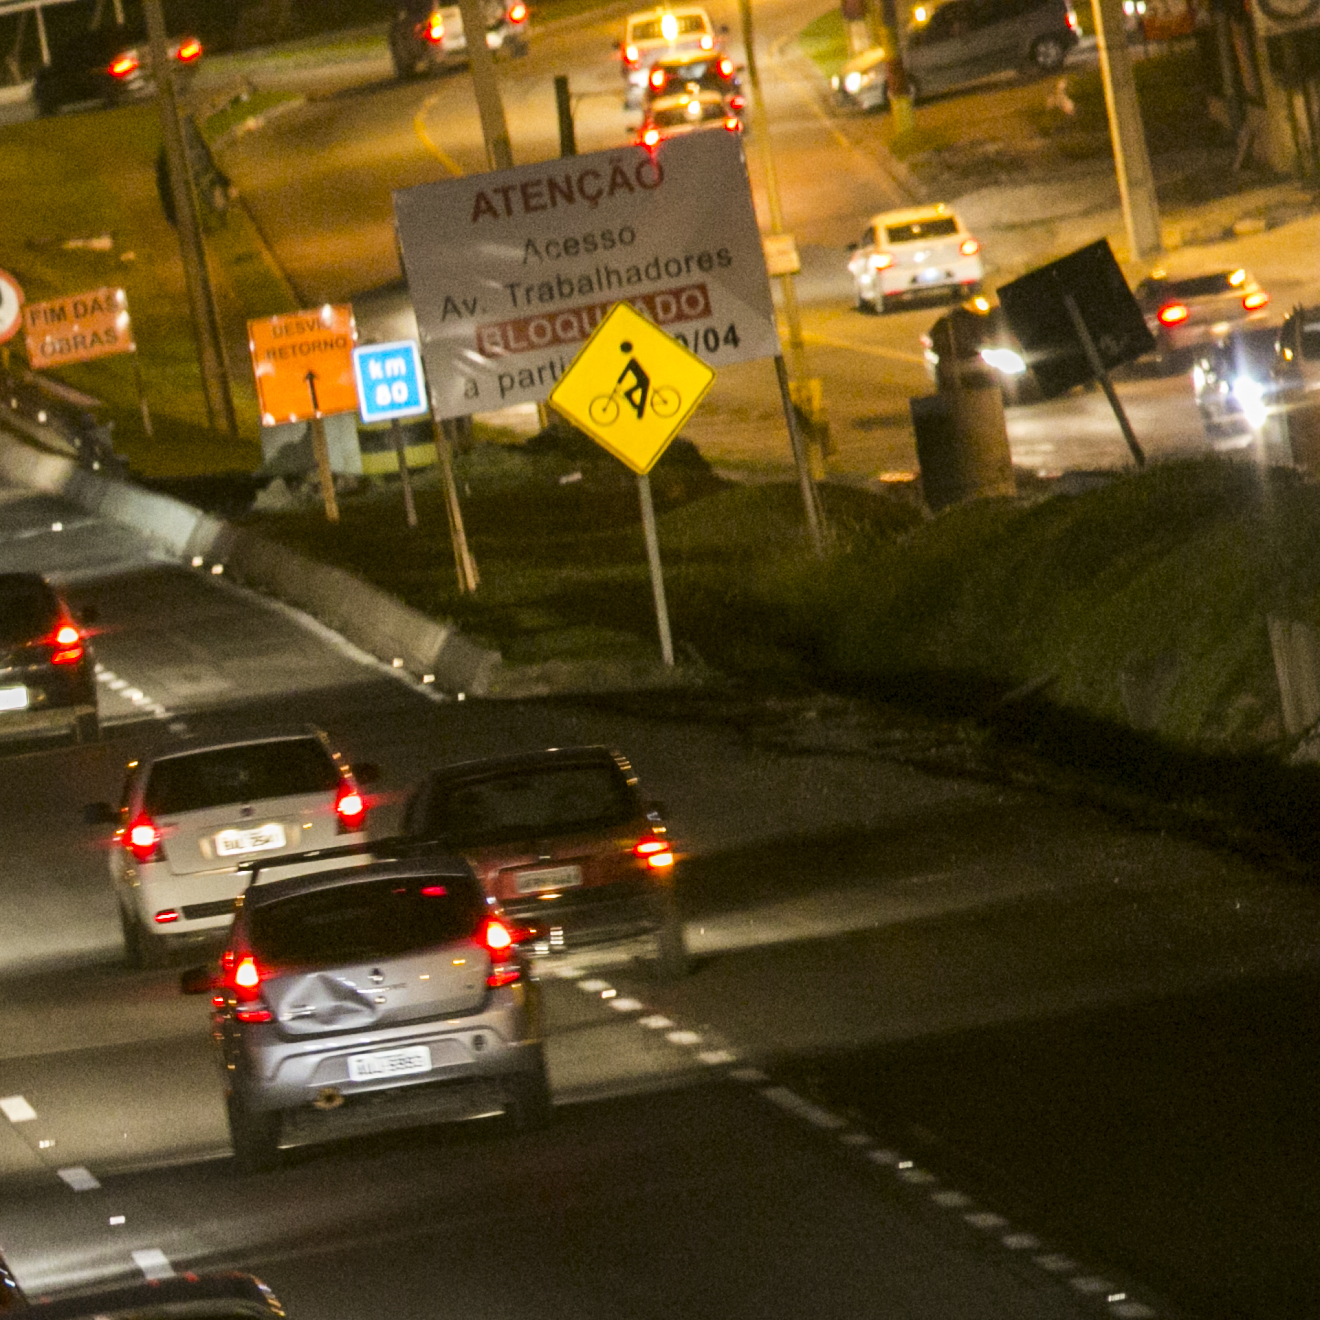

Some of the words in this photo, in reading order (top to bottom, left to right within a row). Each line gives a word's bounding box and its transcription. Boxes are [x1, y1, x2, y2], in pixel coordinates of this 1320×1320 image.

[471, 156, 665, 224] ATENÇÃO
[522, 223, 636, 265] Acesso
[441, 295, 487, 323] Av.
[505, 246, 734, 309] Trabalhadores
[28, 304, 67, 327] FIM
[73, 291, 119, 320] DAS
[479, 288, 707, 356] BLOQUADO
[39, 326, 119, 359] OBRAS
[264, 335, 348, 362] RETORNO
[368, 356, 407, 380] km
[463, 379, 480, 400] a
